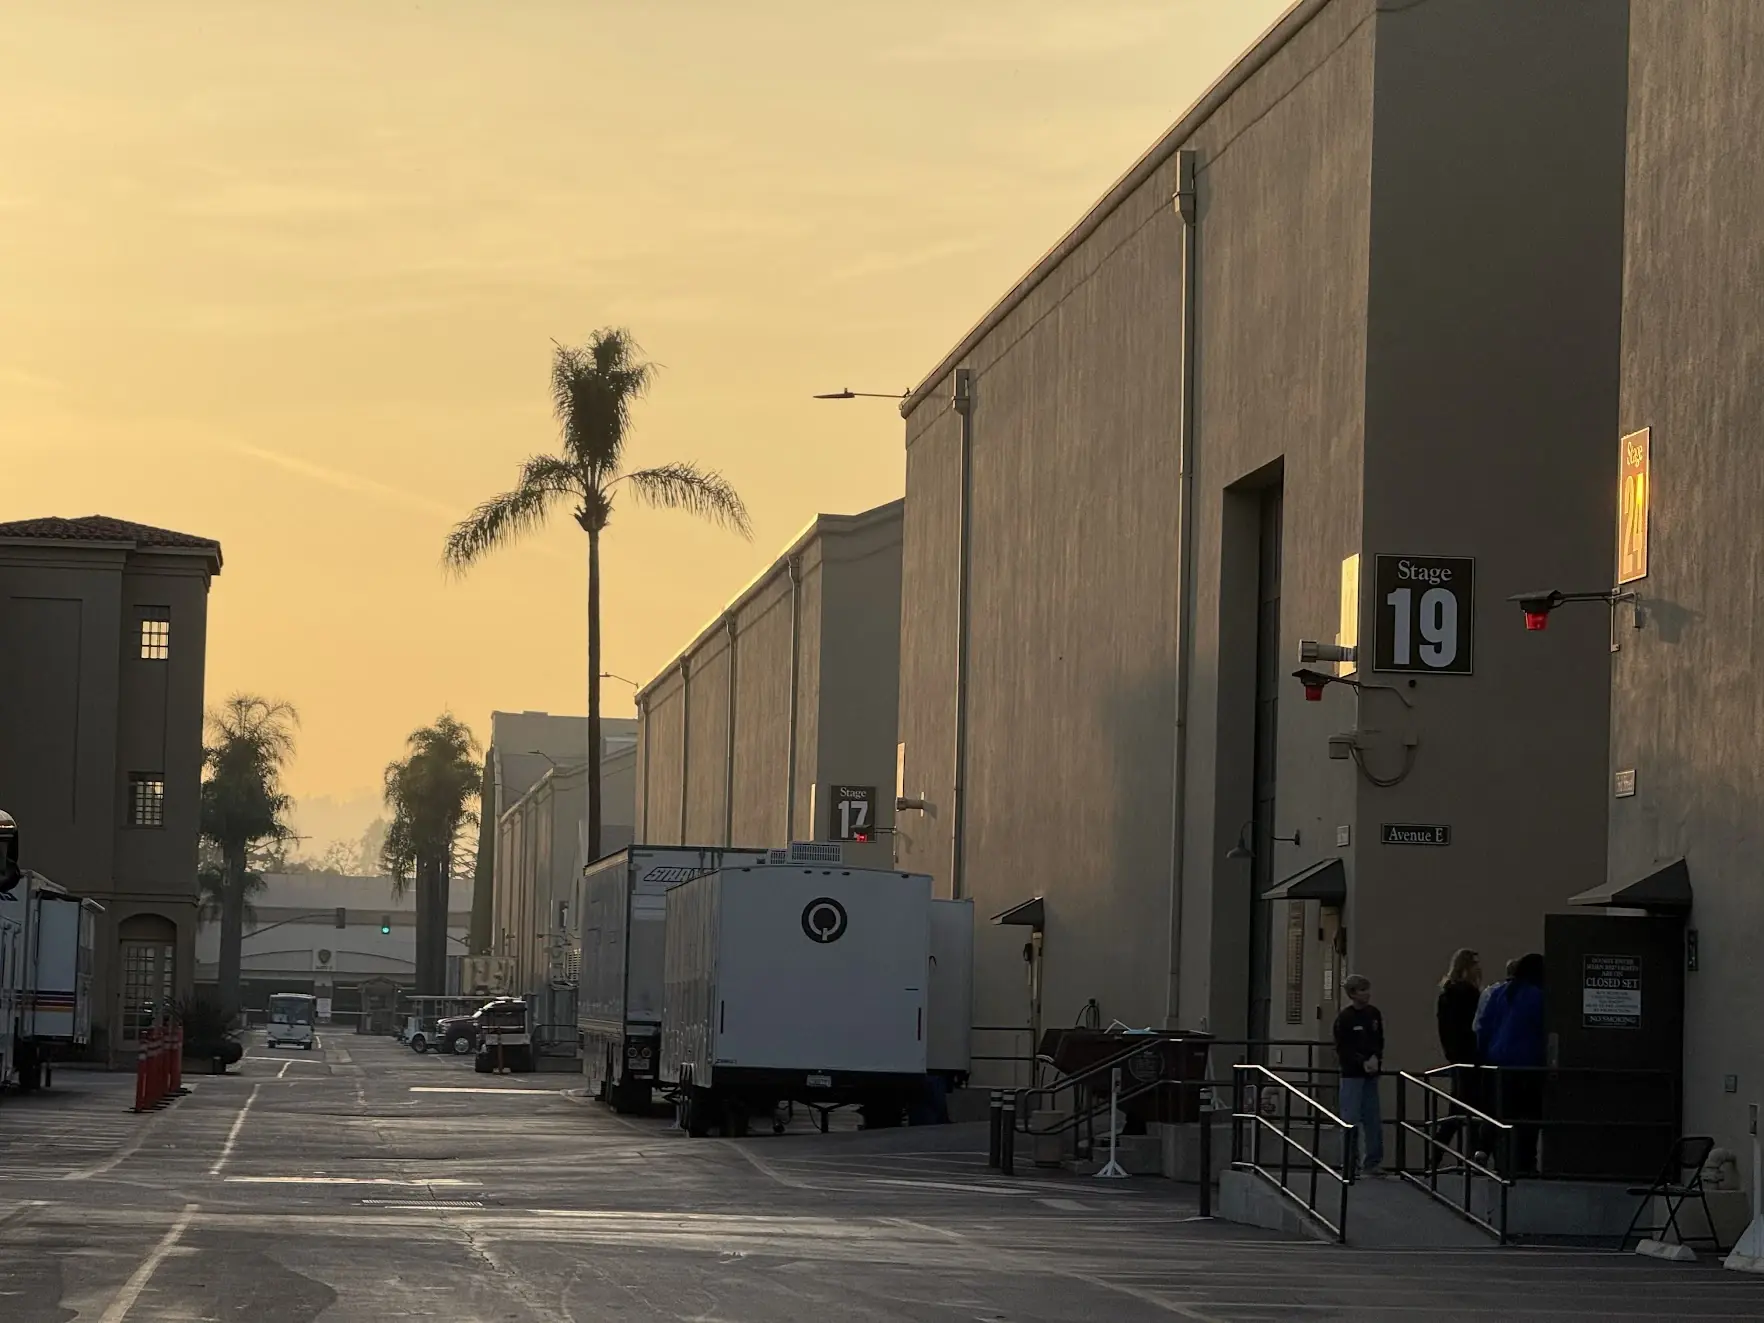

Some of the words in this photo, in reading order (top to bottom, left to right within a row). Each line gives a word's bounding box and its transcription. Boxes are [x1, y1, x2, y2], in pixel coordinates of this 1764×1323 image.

[1626, 441, 1643, 468] Stage
[1622, 472, 1644, 575] 24
[1397, 559, 1453, 585] Stage
[1386, 587, 1458, 668] 19
[840, 787, 867, 799] Stage
[837, 800, 869, 839] 17
[1388, 827, 1432, 842] Avenue
[1435, 827, 1444, 843] E
[1586, 977, 1620, 988] CLOSED
[1622, 978, 1638, 989] SET
